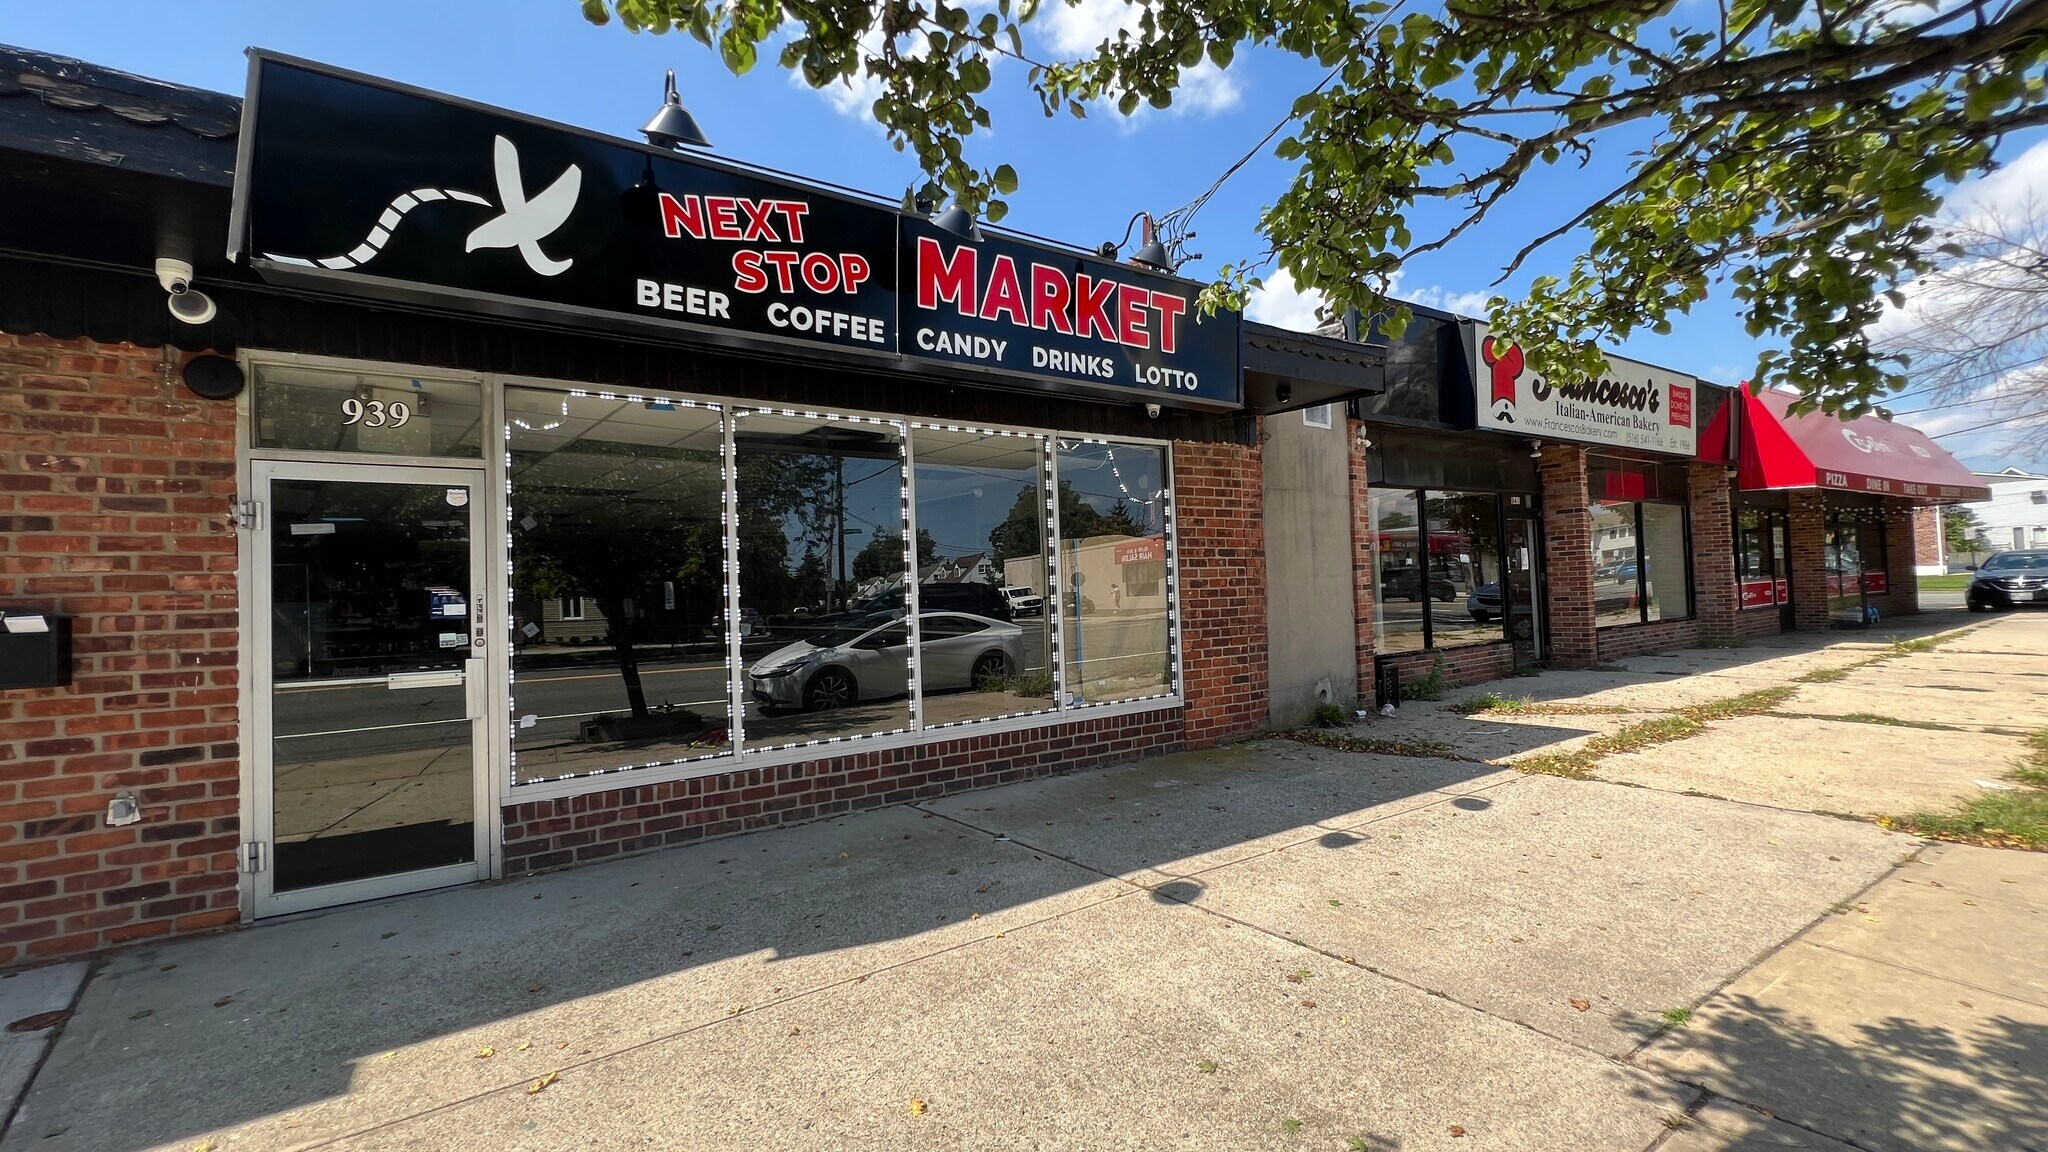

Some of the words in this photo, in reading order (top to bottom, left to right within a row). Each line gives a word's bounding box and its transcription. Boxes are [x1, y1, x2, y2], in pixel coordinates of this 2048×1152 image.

[658, 192, 809, 243] NEXT
[732, 249, 871, 294] STOP
[916, 236, 1187, 354] MARKET
[636, 278, 731, 320] BEER
[767, 302, 885, 344] COFFEE
[916, 327, 1007, 362] CANDY
[1032, 346, 1114, 378] DRINKS
[1135, 363, 1199, 391] LOTTO
[1670, 400, 1683, 411] DONE
[1683, 403, 1690, 412] ON
[1672, 389, 1688, 401] BAKING
[341, 398, 410, 428] 939
[1555, 400, 1631, 428] Italian-American
[1632, 415, 1660, 436] Bakery
[1671, 411, 1689, 423] PREMISES
[1524, 417, 1618, 440] www.FrancescosBakery.com
[1826, 472, 1848, 487] PIZZA
[1866, 478, 1882, 491] DINE
[1882, 479, 1890, 492] IN
[1903, 483, 1917, 495] TAKE
[1917, 484, 1928, 496] OUT
